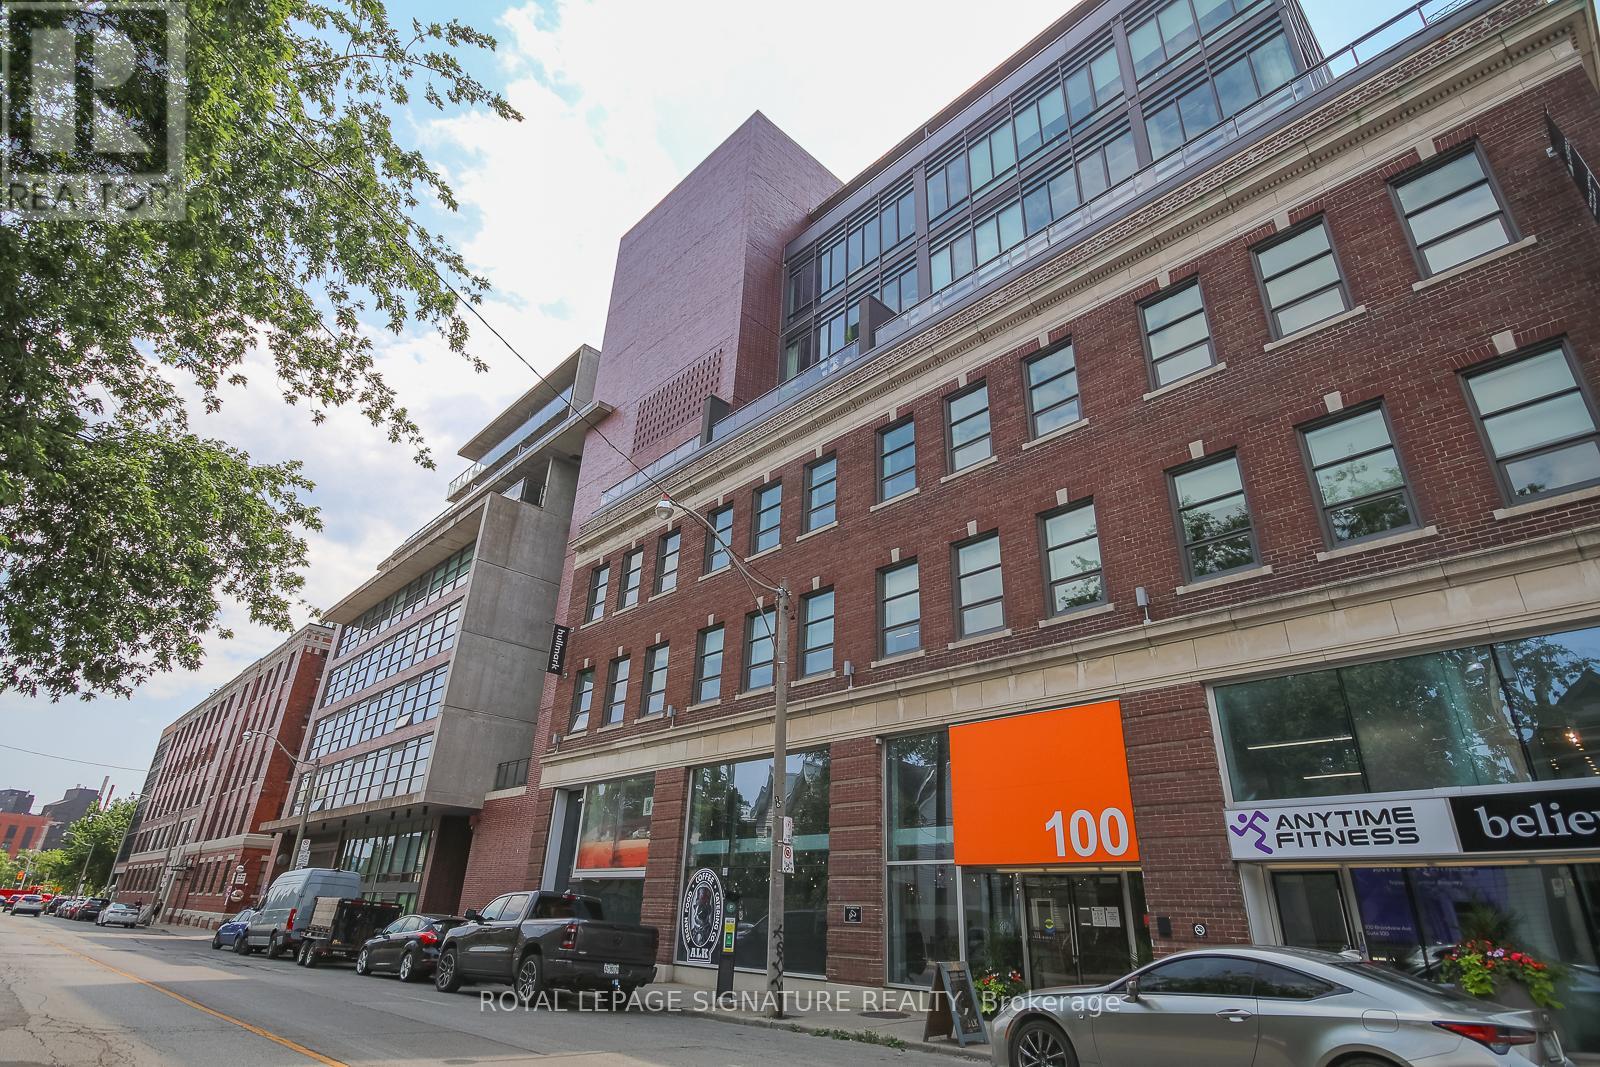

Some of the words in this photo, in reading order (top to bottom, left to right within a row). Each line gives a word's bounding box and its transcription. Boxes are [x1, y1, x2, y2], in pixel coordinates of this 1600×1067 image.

[551, 628, 566, 670] hullmark
[1275, 806, 1416, 831] ANYTIME
[1045, 807, 1129, 857] 100
[1275, 826, 1420, 849] FITNESS
[696, 873, 714, 884] COFFEE
[690, 947, 709, 959] ALK
